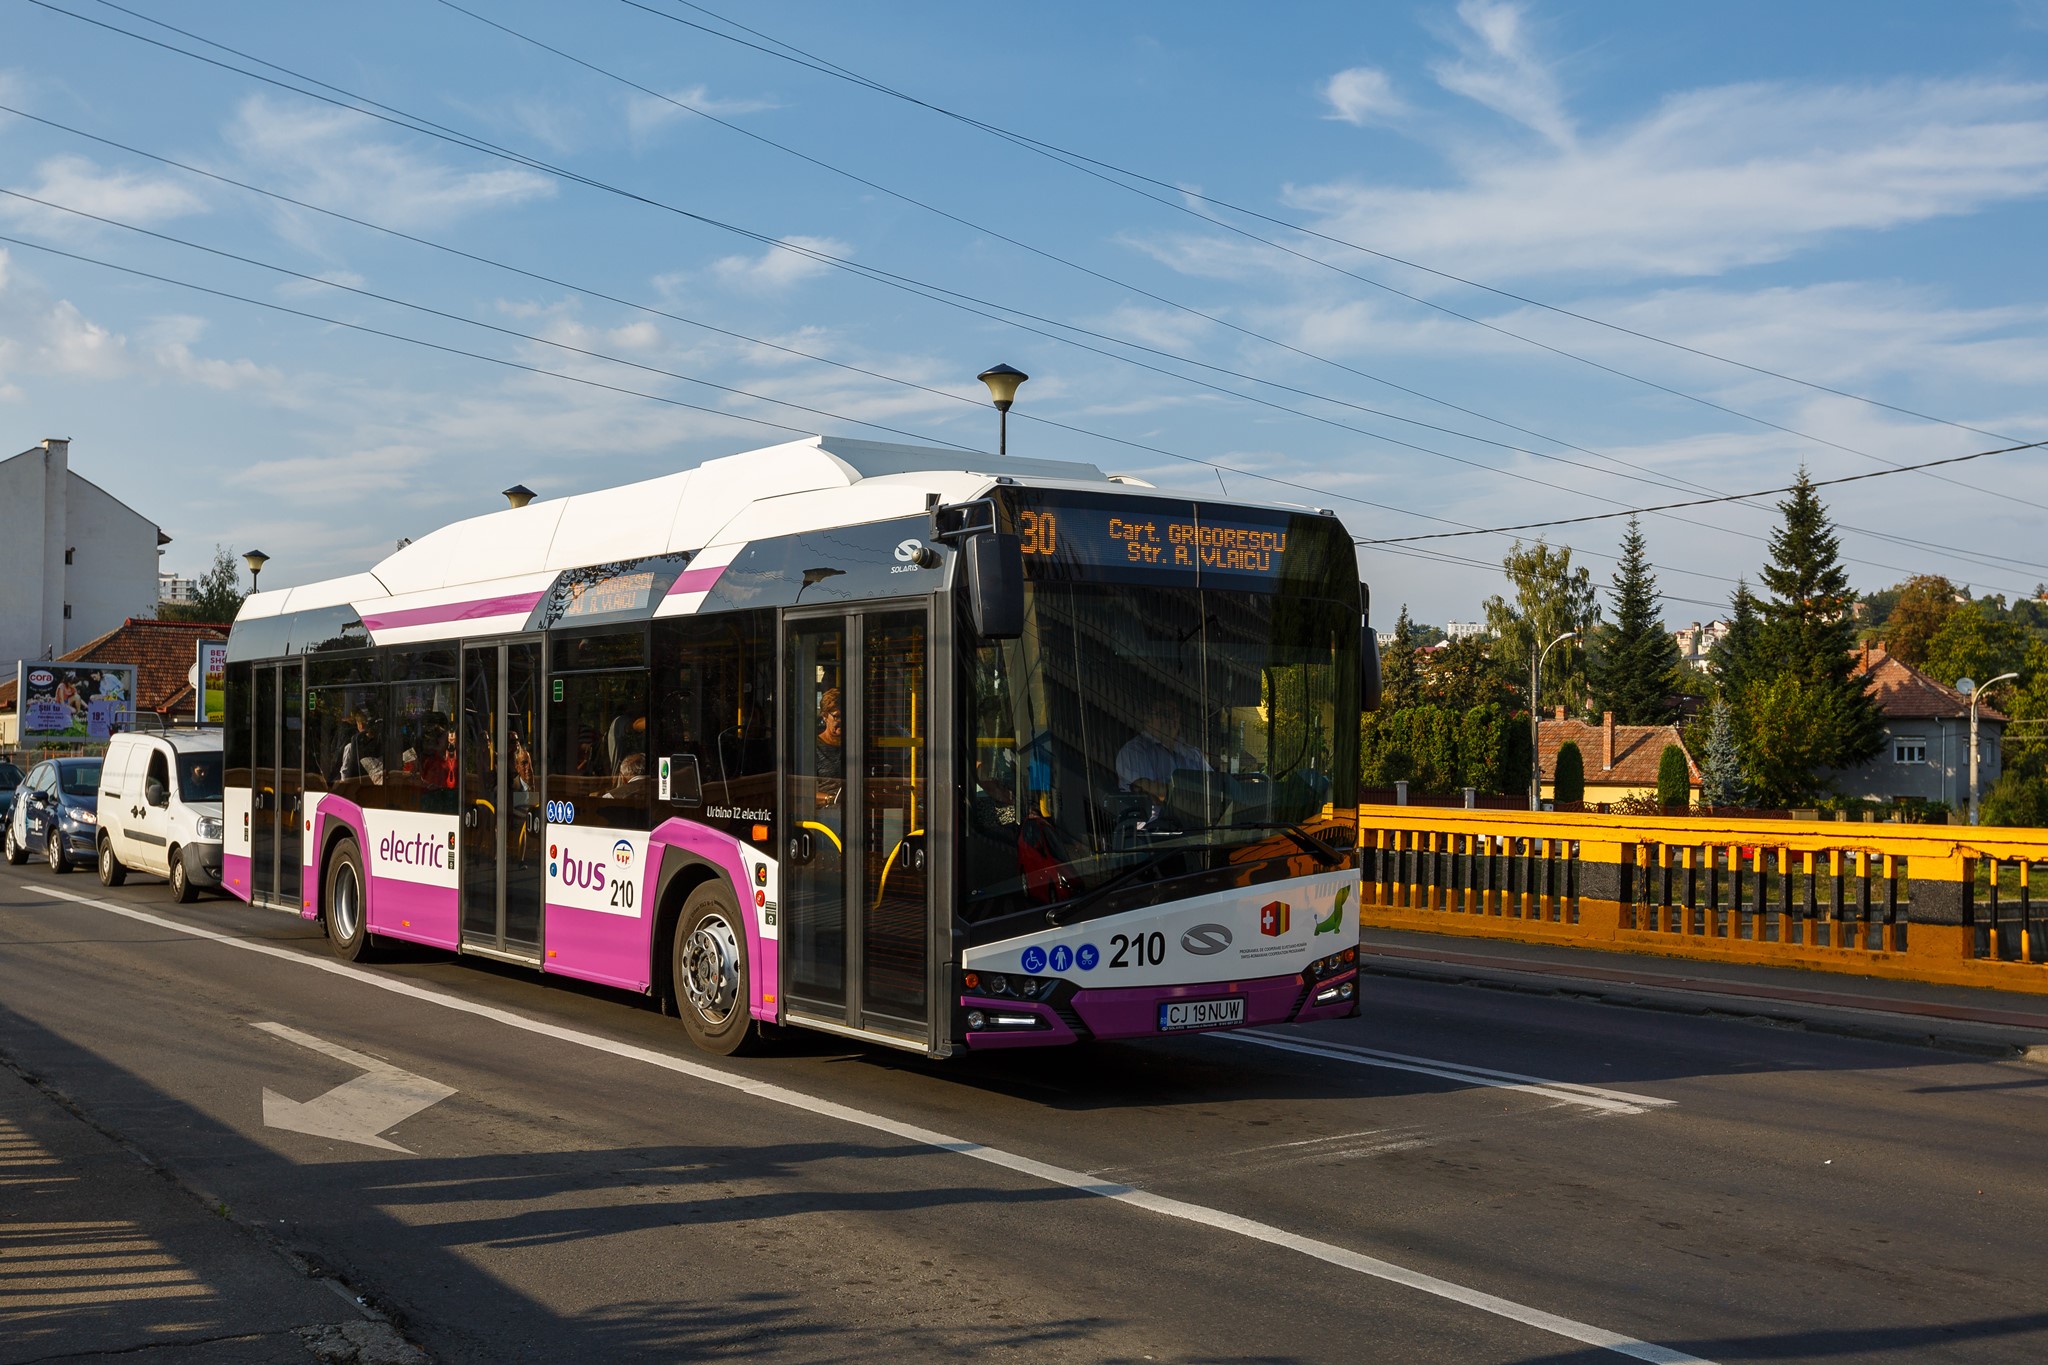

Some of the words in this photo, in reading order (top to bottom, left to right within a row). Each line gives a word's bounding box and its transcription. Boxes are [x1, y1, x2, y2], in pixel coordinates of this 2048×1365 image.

[1021, 511, 1056, 554] 30
[1109, 518, 1160, 542] Cart.
[1168, 523, 1287, 552] GRIGORESCU
[890, 564, 919, 574] SOLARIS
[1127, 541, 1167, 564] Str.
[1175, 545, 1193, 565] A.
[1201, 547, 1270, 571] VLAICU
[29, 673, 52, 682] cora
[706, 805, 732, 819] Urbino
[732, 806, 741, 819] 12
[741, 808, 772, 821] electric
[379, 829, 444, 868] electric
[562, 847, 606, 891] bus
[610, 879, 634, 909] 210
[1108, 931, 1166, 969] 210
[1169, 1005, 1188, 1024] CJ
[1193, 1004, 1206, 1022] 19
[1208, 1001, 1240, 1021] NUW
